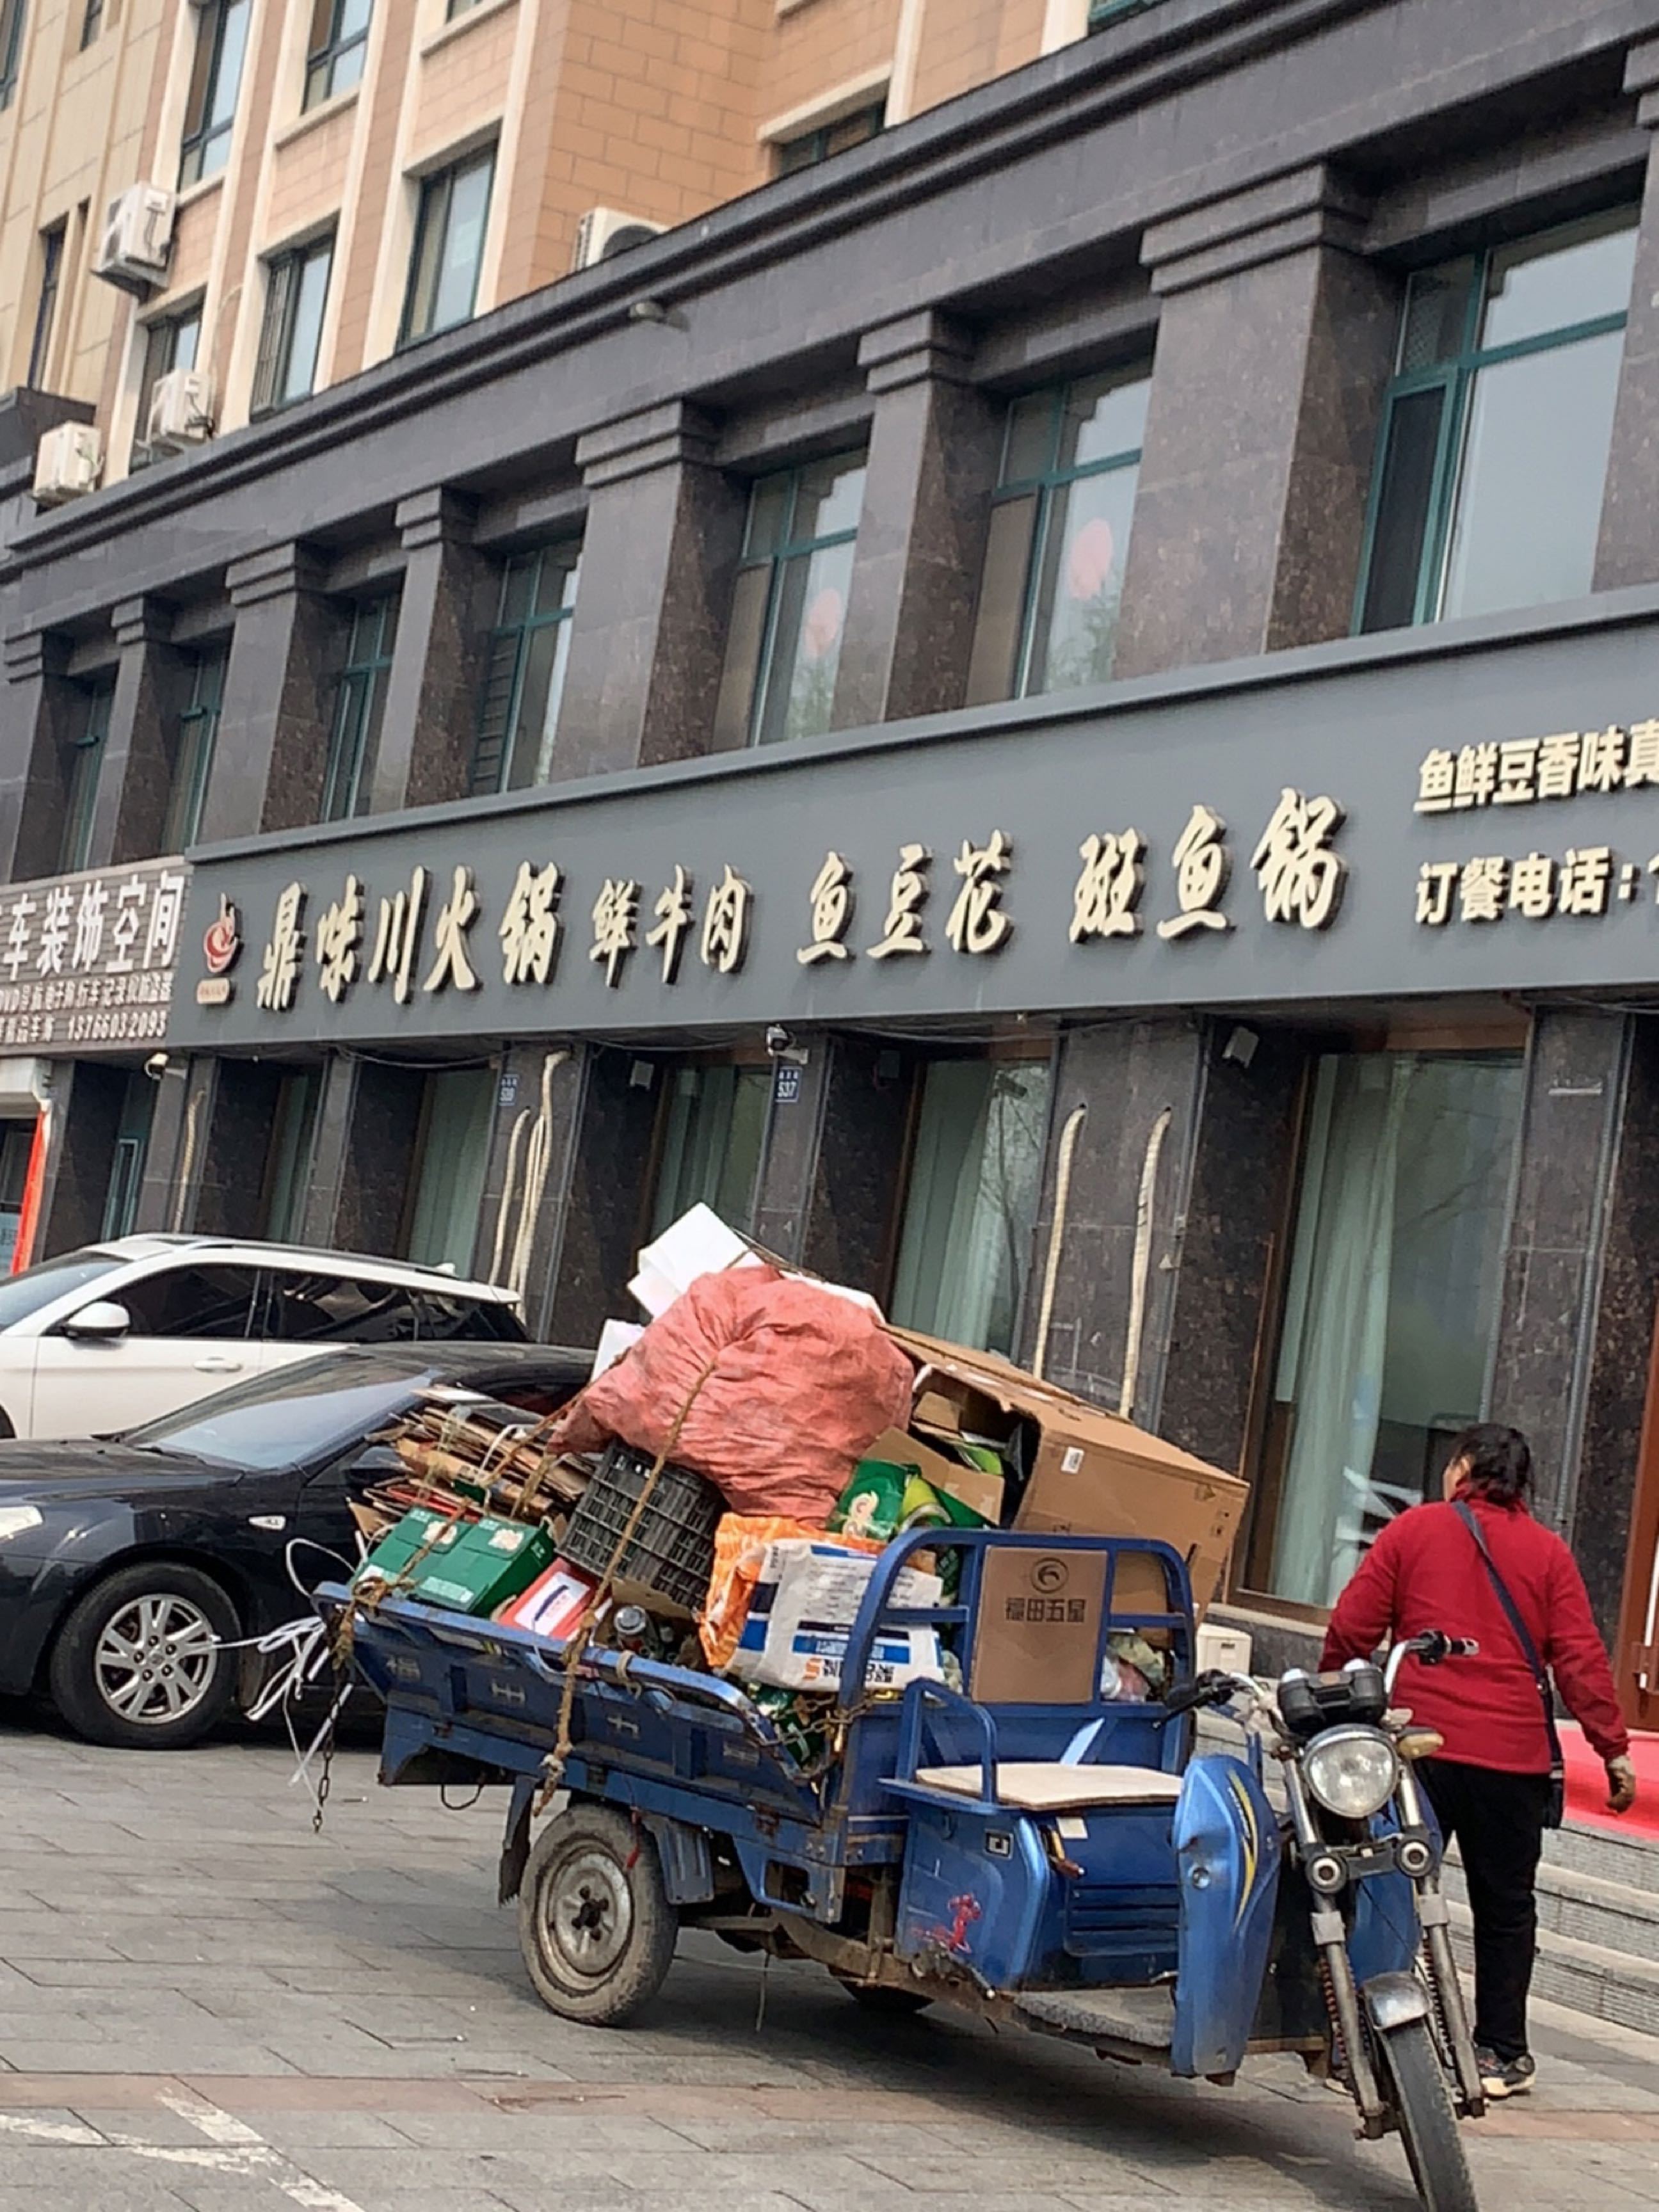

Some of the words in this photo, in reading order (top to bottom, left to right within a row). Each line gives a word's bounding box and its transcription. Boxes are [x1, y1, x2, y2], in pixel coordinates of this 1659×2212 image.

[589, 864, 746, 986] 鲜牛肉
[797, 829, 1006, 964] 鱼豆花
[1006, 1598, 1086, 1623] 福田五星
